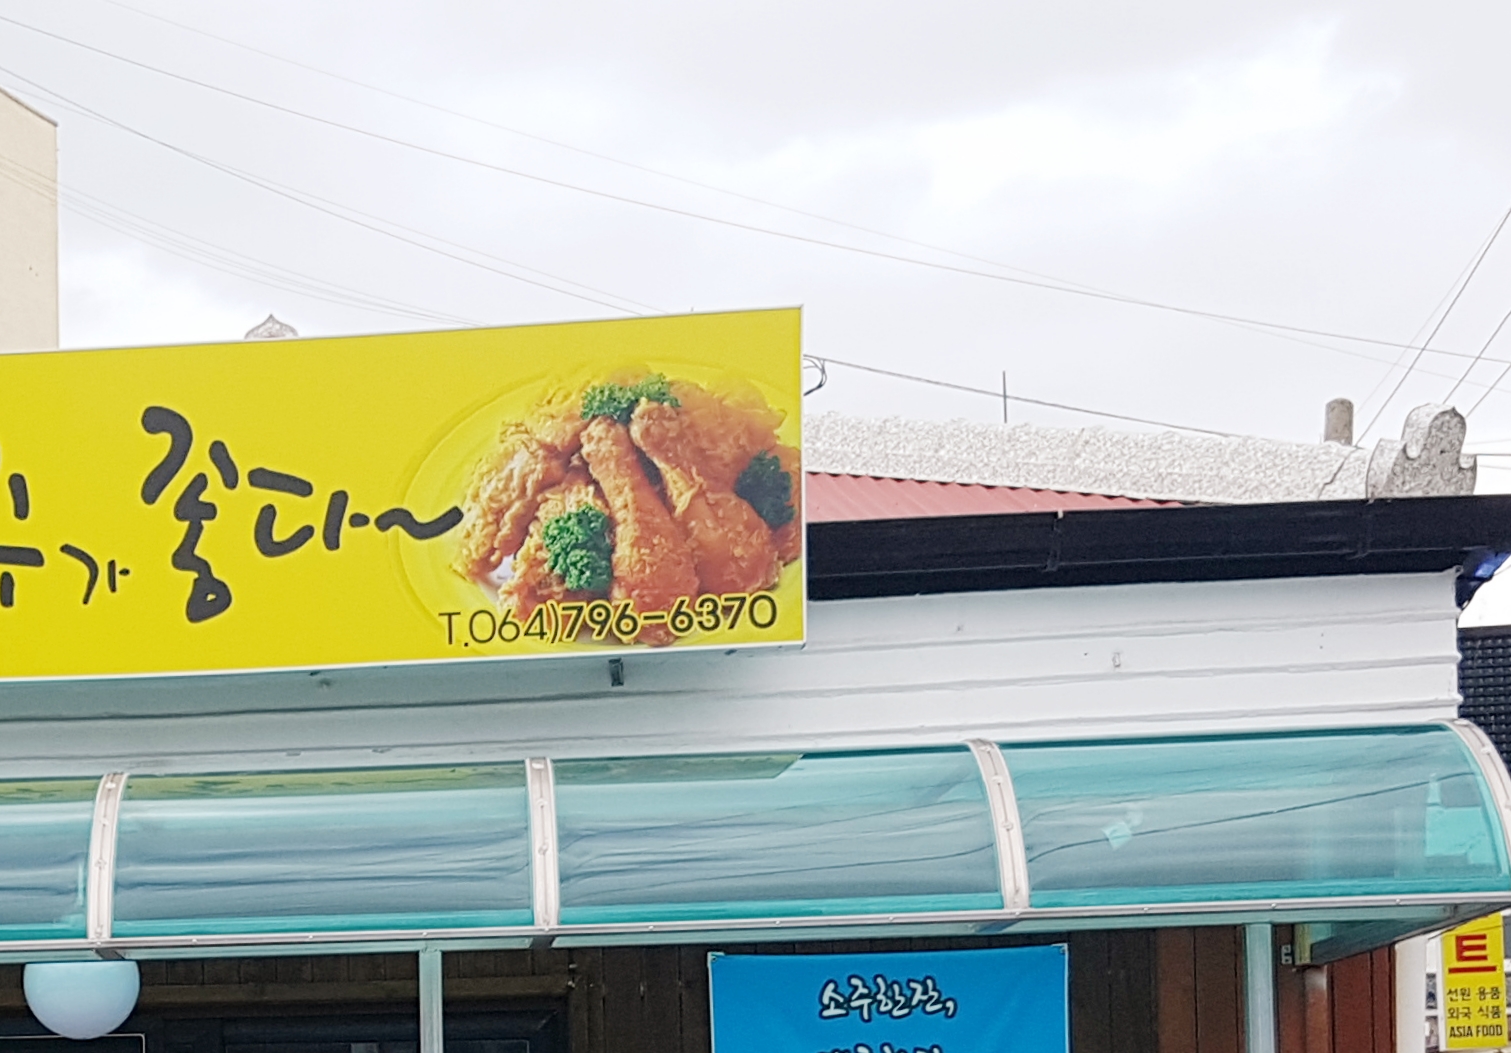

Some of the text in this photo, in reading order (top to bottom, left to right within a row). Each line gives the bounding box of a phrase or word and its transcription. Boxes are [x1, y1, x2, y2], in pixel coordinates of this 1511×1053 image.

[438, 591, 778, 648] T.064)796-6370
[821, 976, 956, 1019] 소주한잔,
[1447, 985, 1500, 1002] 선원 용품
[1448, 1005, 1502, 1020] 외국 식품
[1449, 1024, 1503, 1038] ASIA FOOD
